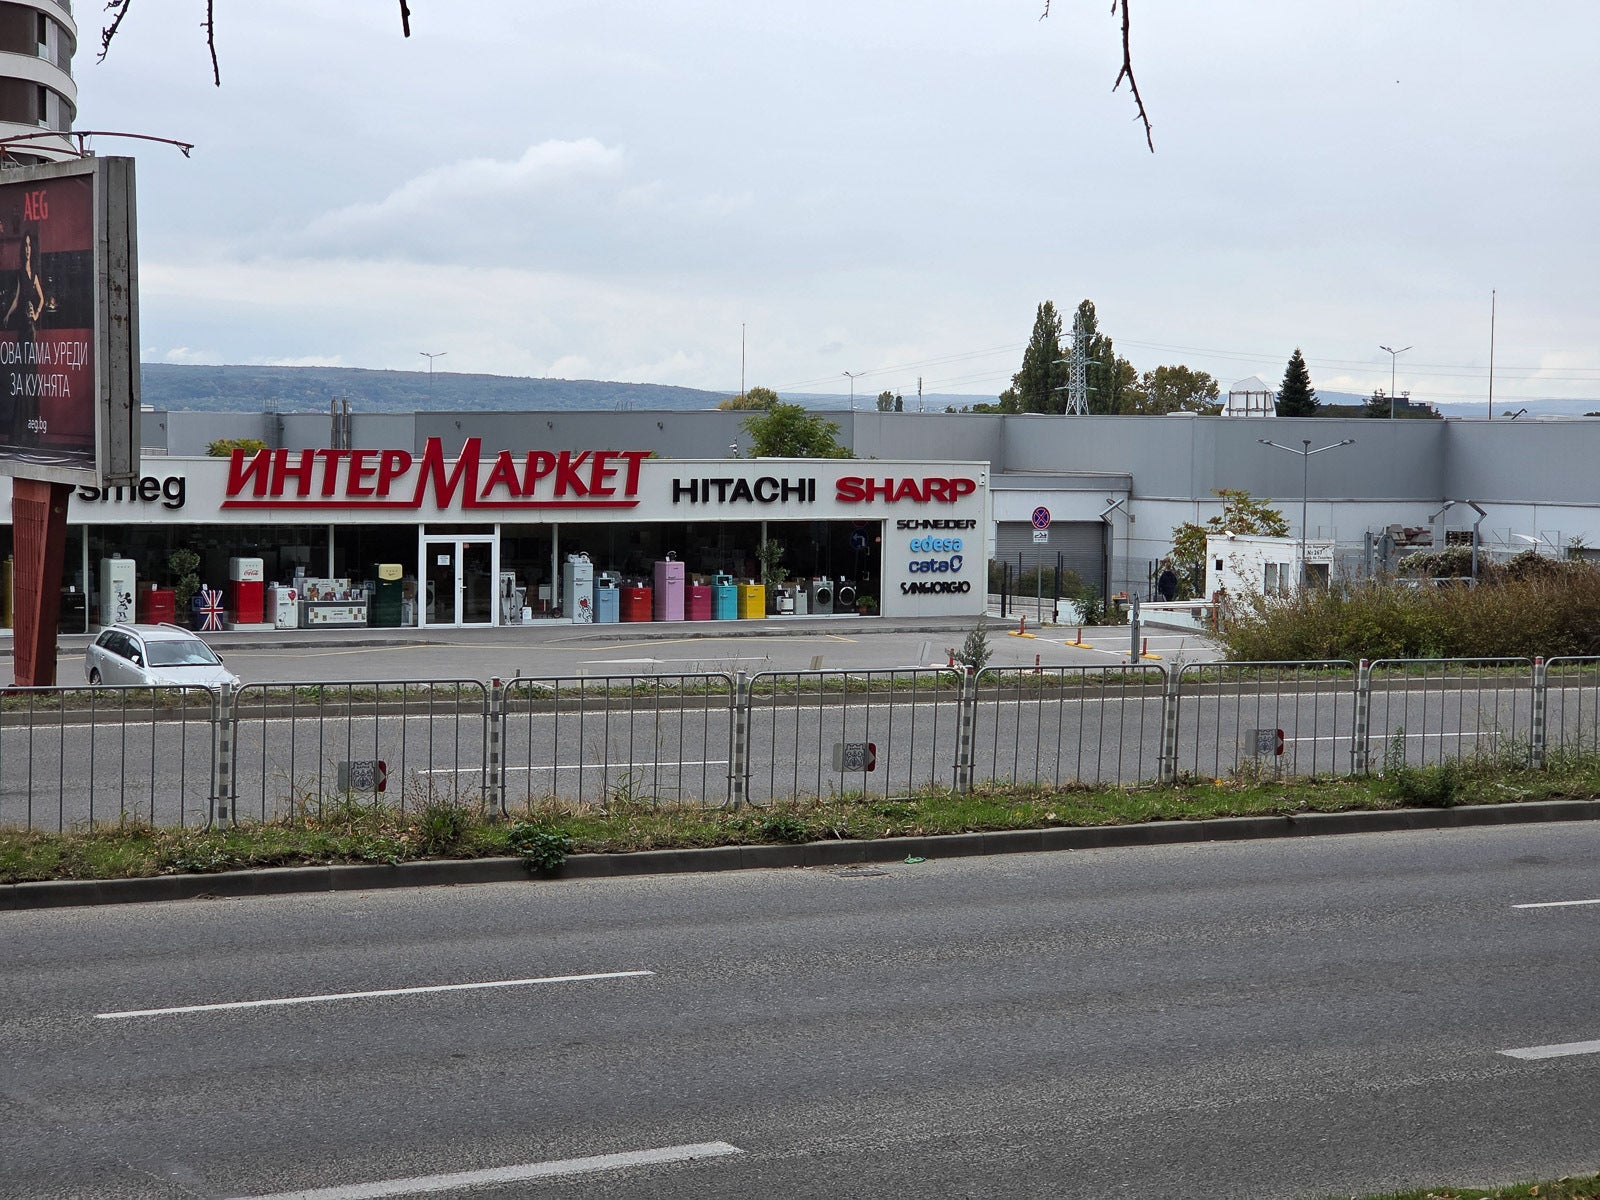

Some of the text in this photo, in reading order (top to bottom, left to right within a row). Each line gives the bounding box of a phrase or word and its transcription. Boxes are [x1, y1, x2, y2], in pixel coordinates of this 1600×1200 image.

[24, 190, 49, 221] AEG
[24, 342, 52, 365] ГАМА
[53, 342, 88, 371] УРЕДИ
[10, 372, 71, 398] ЗА КУХНЯТА
[27, 415, 48, 434] aeg.bg
[224, 437, 651, 507] ИНТЕРМАРКЕТ
[672, 476, 816, 504] HITACHI
[835, 476, 977, 503] SHARP
[896, 519, 977, 531] SCHNEIDER
[910, 534, 963, 553] edesa
[900, 580, 971, 596] SANGIORGIO
